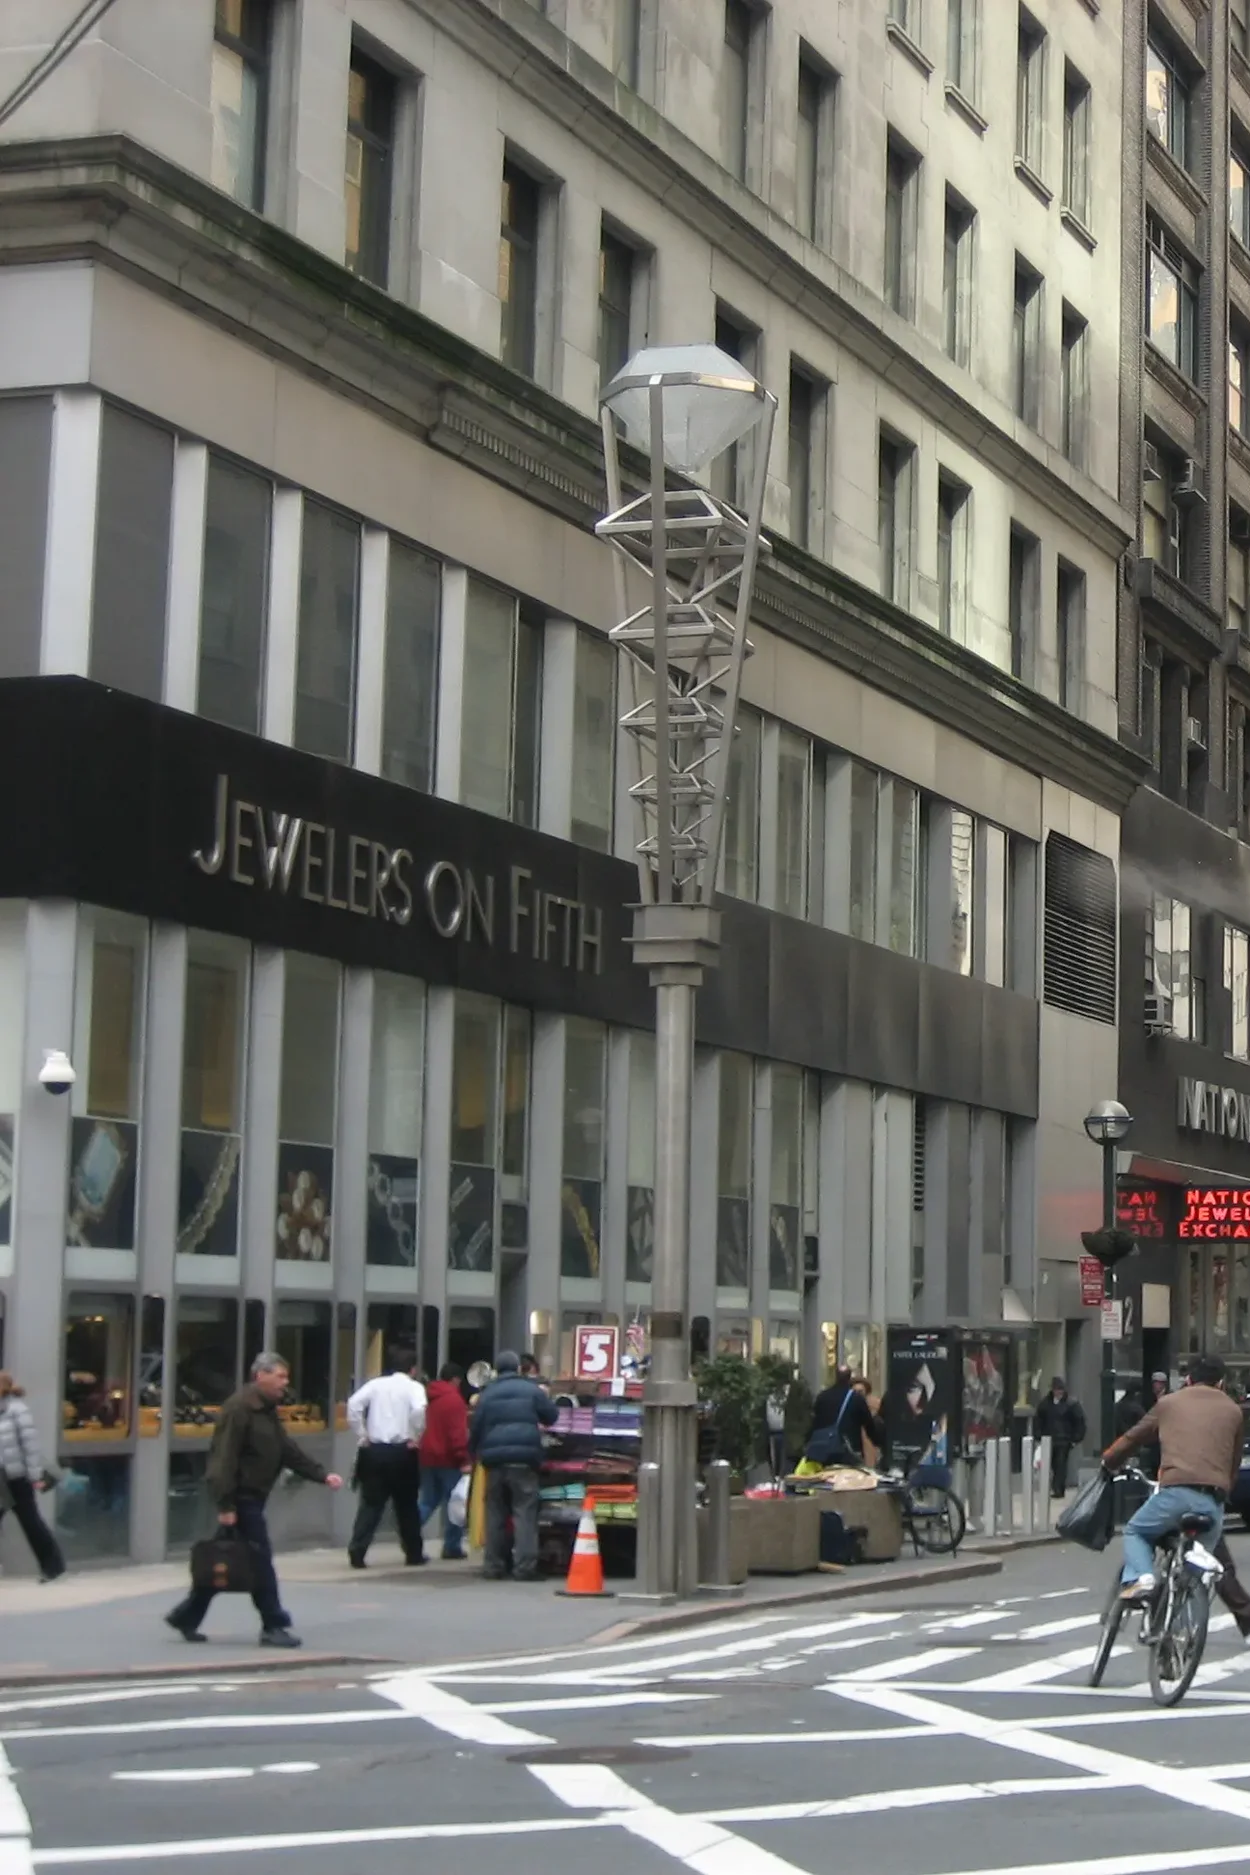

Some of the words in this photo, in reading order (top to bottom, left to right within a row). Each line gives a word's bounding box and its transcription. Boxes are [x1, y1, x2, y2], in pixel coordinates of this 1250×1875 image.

[192, 774, 414, 926] JEWELERS
[424, 860, 495, 948] ON
[510, 864, 604, 976] FIFTH
